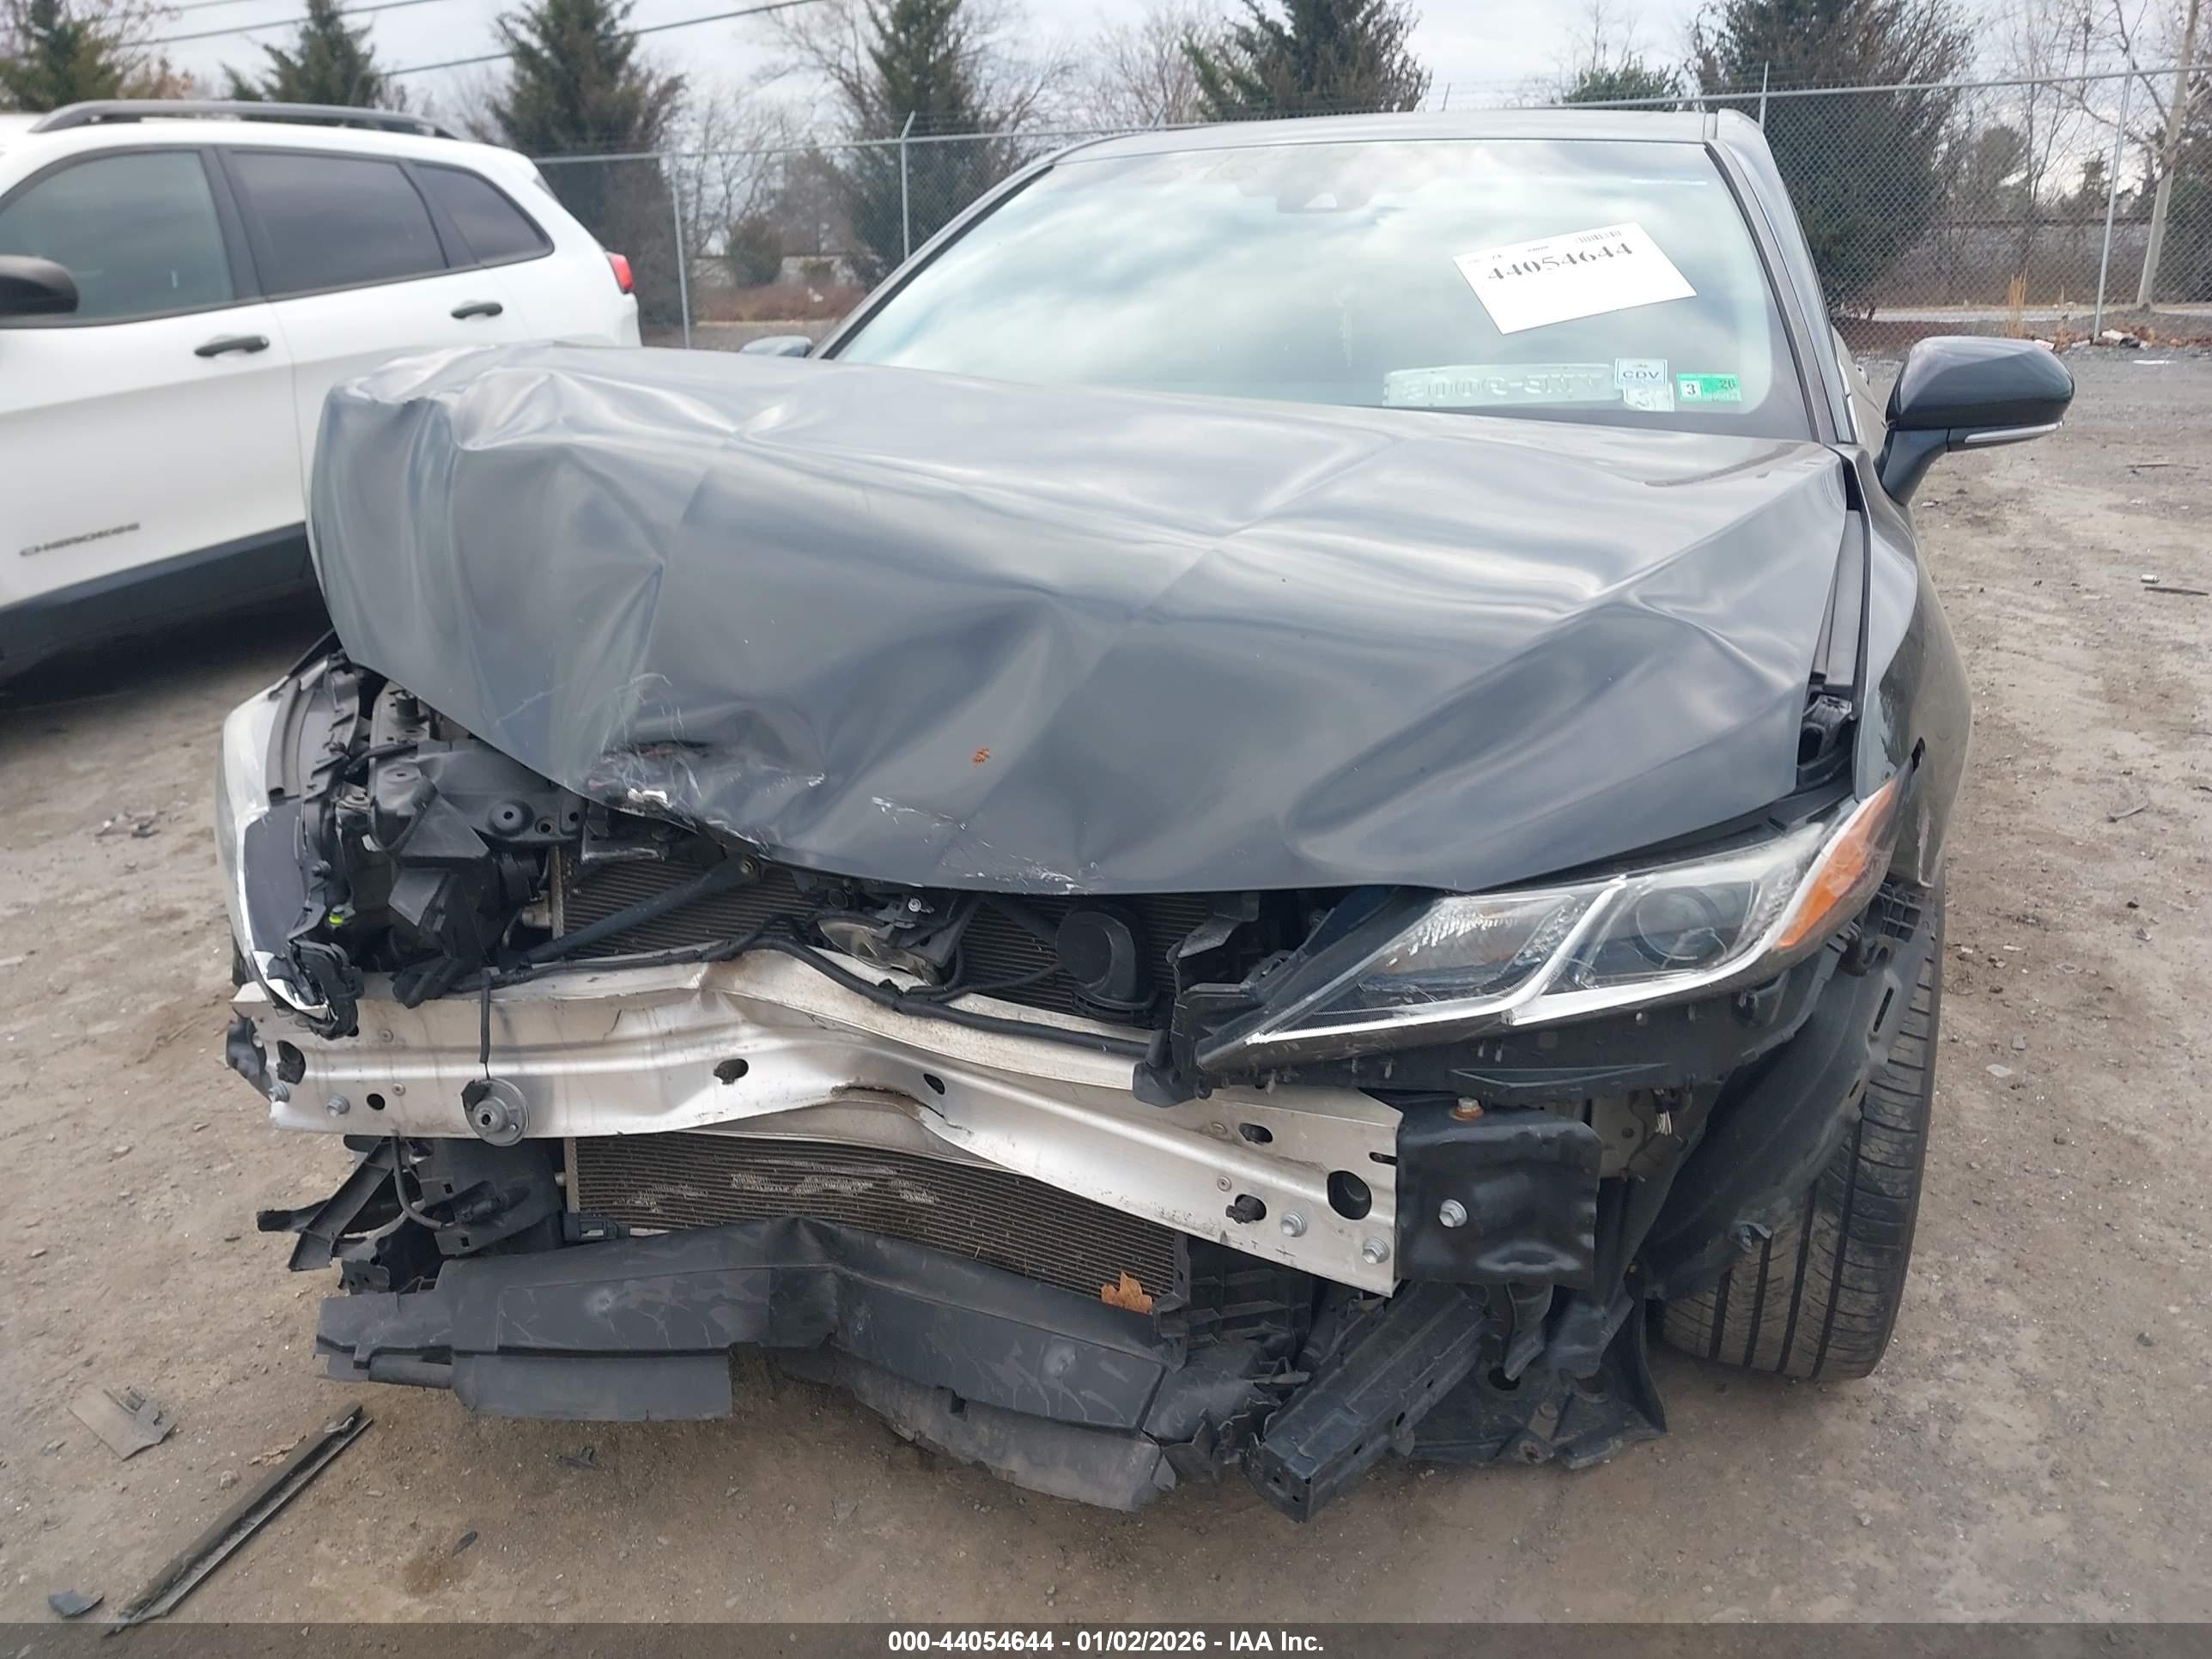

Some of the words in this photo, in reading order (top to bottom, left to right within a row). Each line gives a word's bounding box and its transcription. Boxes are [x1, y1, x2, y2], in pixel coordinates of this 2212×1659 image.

[1487, 242, 1633, 280] 44054644
[1622, 370, 1660, 380] CDV
[1686, 383, 1697, 396] 3
